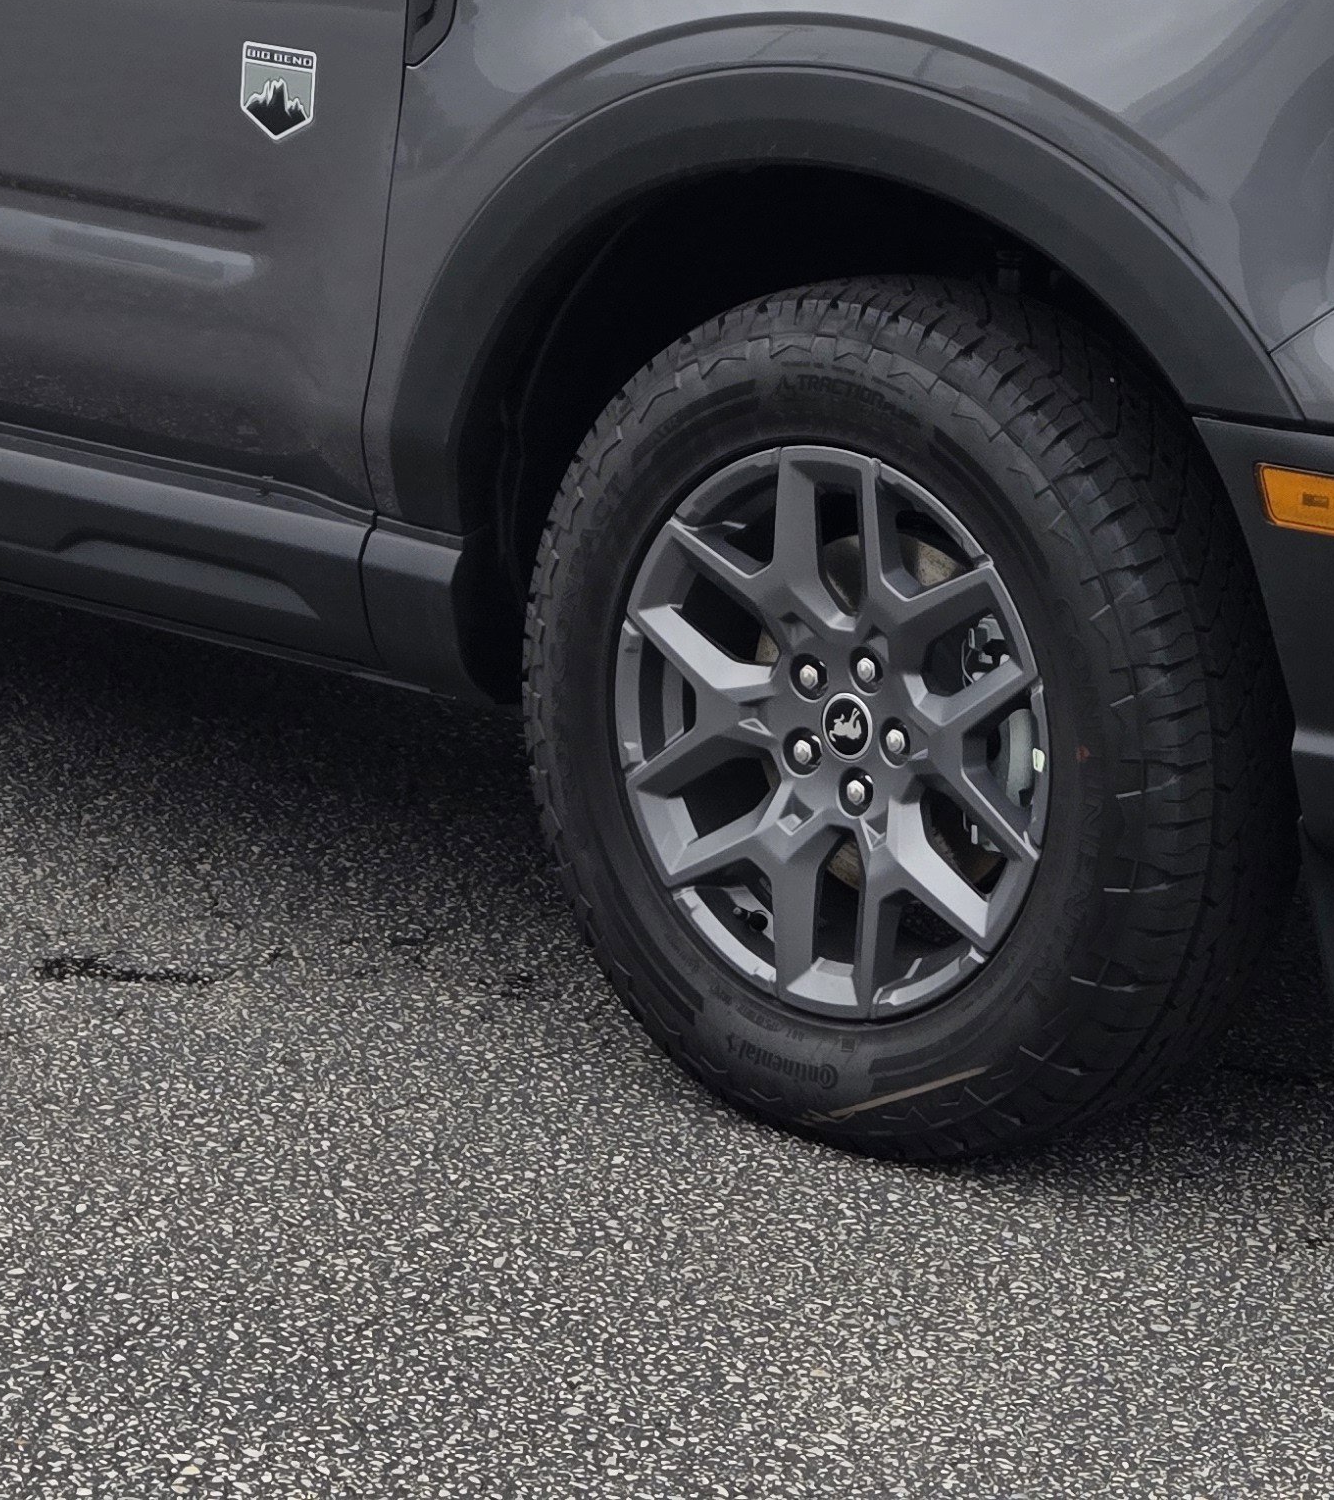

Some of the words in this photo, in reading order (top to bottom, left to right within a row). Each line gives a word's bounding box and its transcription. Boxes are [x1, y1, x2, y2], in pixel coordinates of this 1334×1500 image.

[247, 49, 271, 60] BIG
[274, 54, 312, 66] BEND
[738, 1040, 838, 1089] Continental
